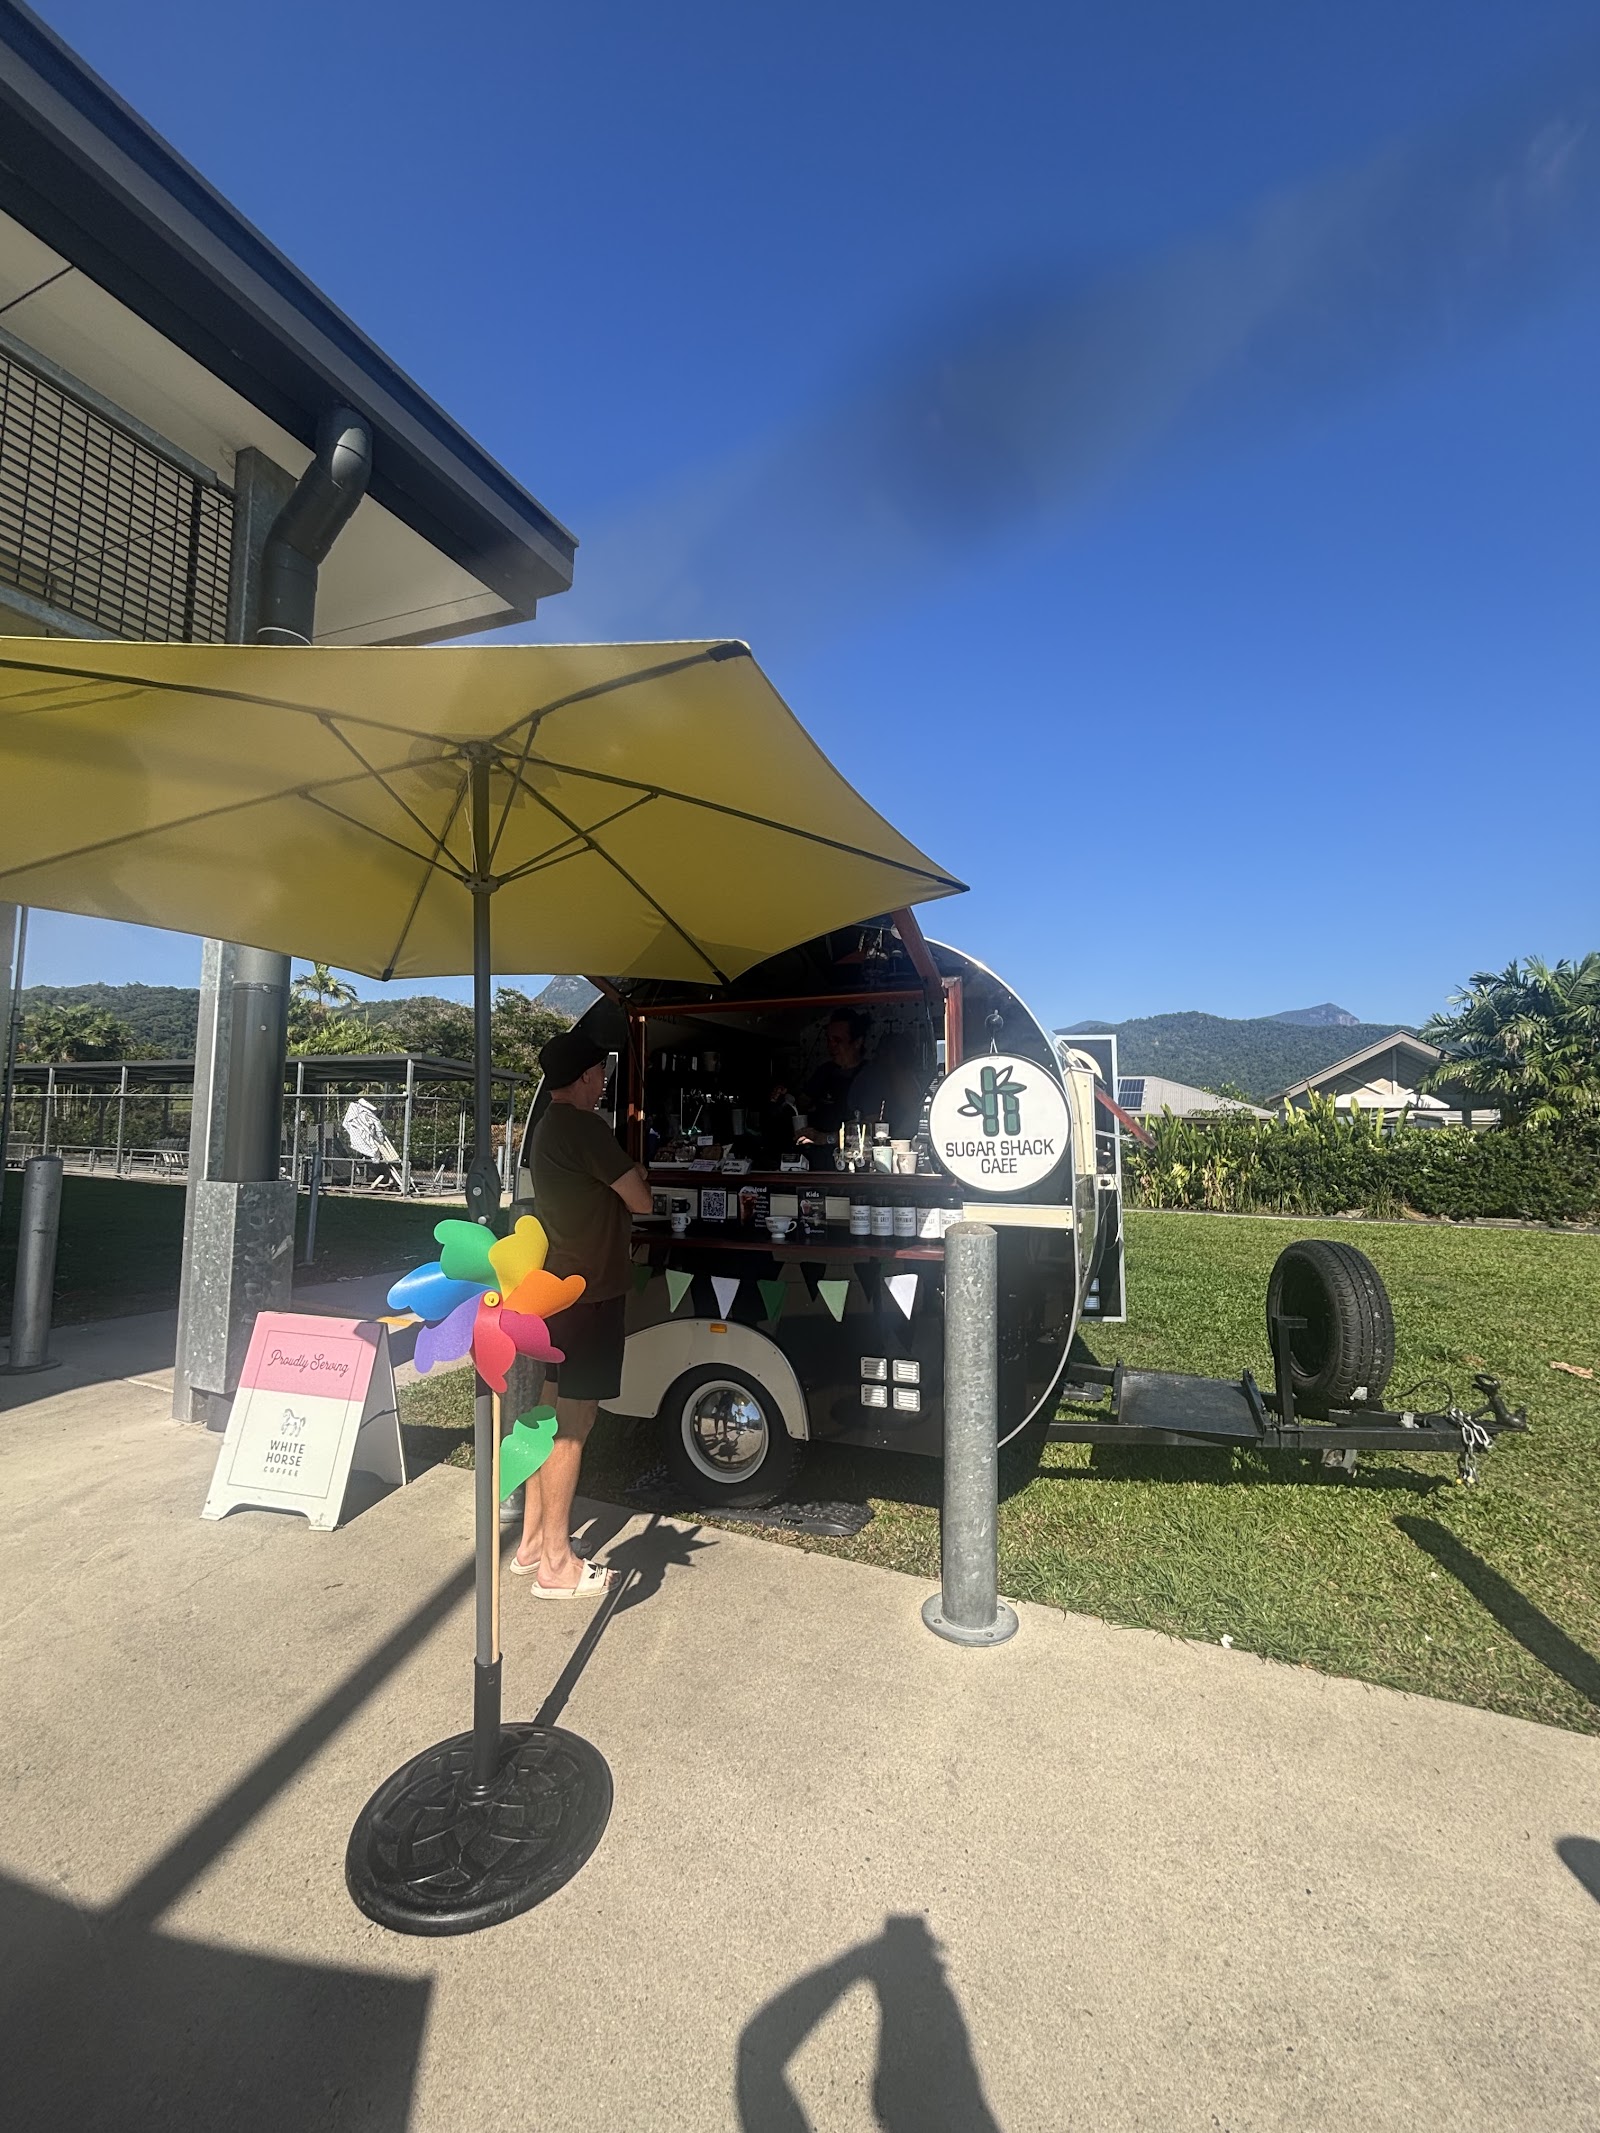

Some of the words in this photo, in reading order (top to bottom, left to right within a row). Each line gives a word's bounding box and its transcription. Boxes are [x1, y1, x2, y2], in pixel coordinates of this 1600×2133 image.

[945, 1141, 996, 1157] SUGAR
[1000, 1138, 1055, 1156] SHACK
[981, 1157, 1018, 1174] CAFE
[267, 1349, 309, 1373] Proudly
[309, 1353, 349, 1378] Serving
[270, 1440, 306, 1455] WHITE
[265, 1452, 303, 1467] HORSE
[263, 1465, 299, 1477] COFFEE
